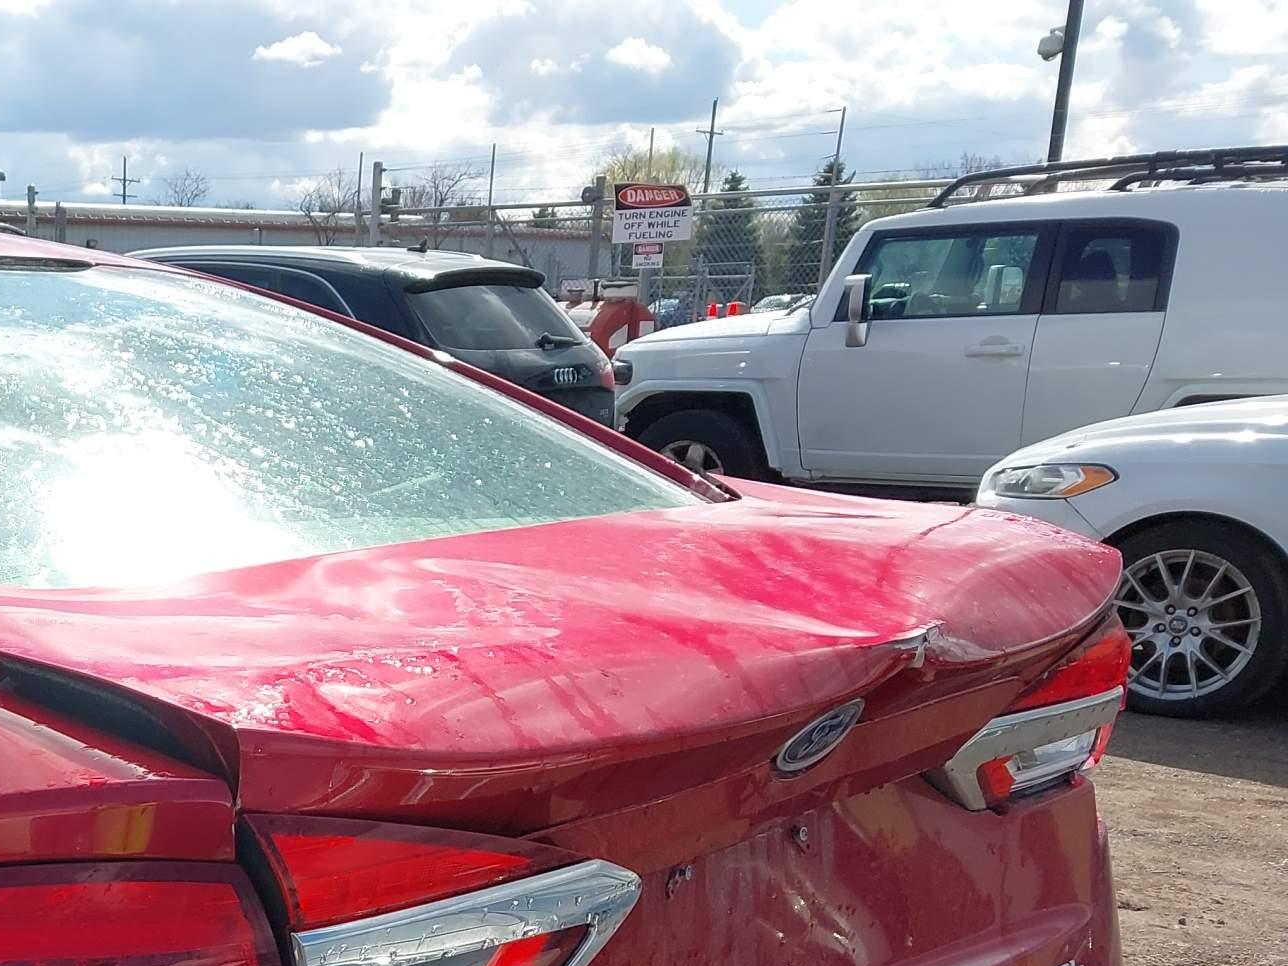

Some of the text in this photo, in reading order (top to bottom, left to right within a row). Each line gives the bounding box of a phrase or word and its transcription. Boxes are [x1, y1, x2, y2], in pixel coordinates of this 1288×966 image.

[626, 189, 680, 203] DANGER
[618, 208, 689, 221] TURN ENGINE
[623, 219, 681, 231] OFF WHILE
[628, 230, 673, 240] FUELING
